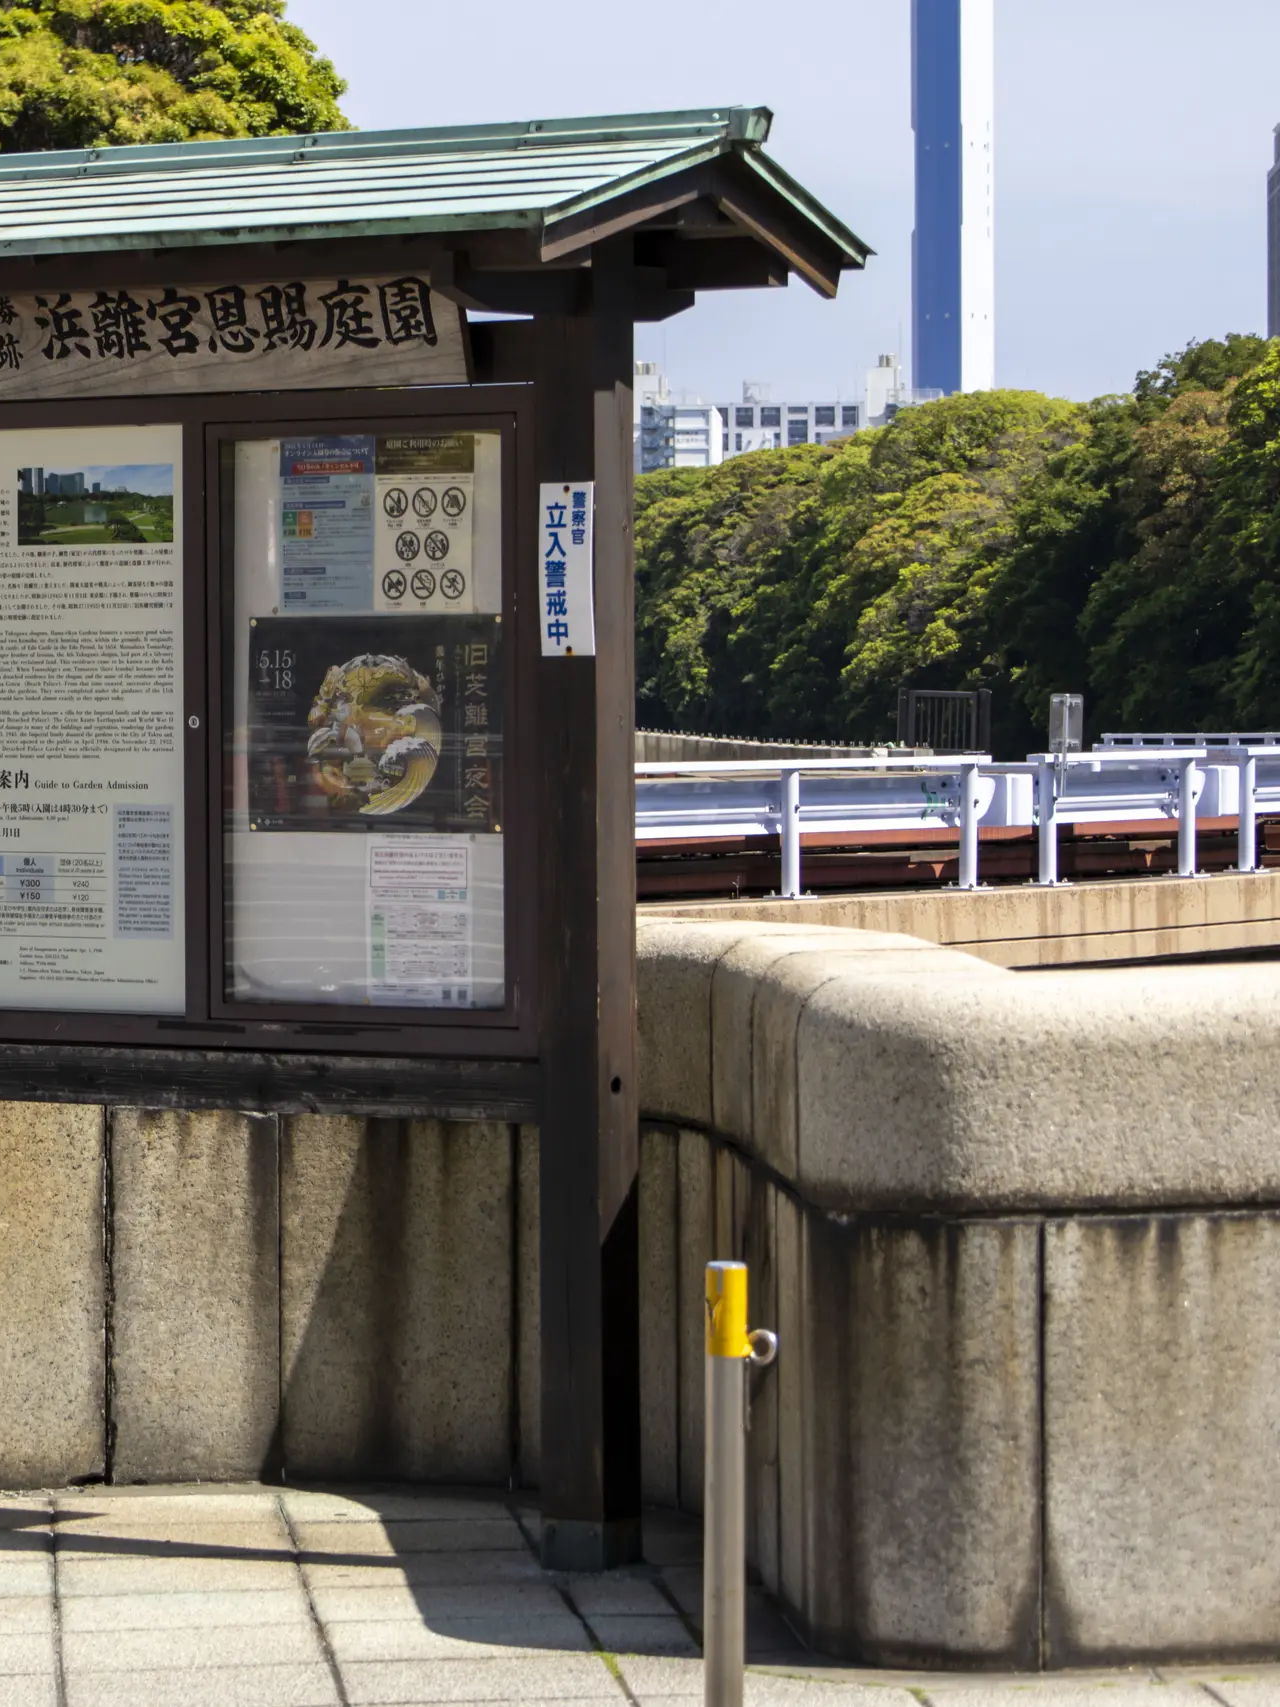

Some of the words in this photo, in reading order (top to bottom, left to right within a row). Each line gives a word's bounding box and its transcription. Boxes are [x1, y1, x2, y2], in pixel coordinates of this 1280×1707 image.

[34, 276, 438, 359] 浜離宮恩賜庭園
[571, 491, 586, 545] 警察官
[545, 502, 569, 646] 立入警戒中
[259, 649, 292, 669] 5.15
[275, 670, 292, 689] 18
[464, 644, 490, 819] 旧芝離宮夜会
[34, 780, 58, 789] Guide
[61, 780, 70, 789] to
[73, 780, 103, 789] Garden
[106, 780, 149, 789] Admission
[23, 858, 37, 866] 個人
[20, 879, 41, 887] ¥300
[72, 880, 90, 888] ¥240
[20, 892, 41, 900] ¥150
[72, 894, 90, 902] ¥120
